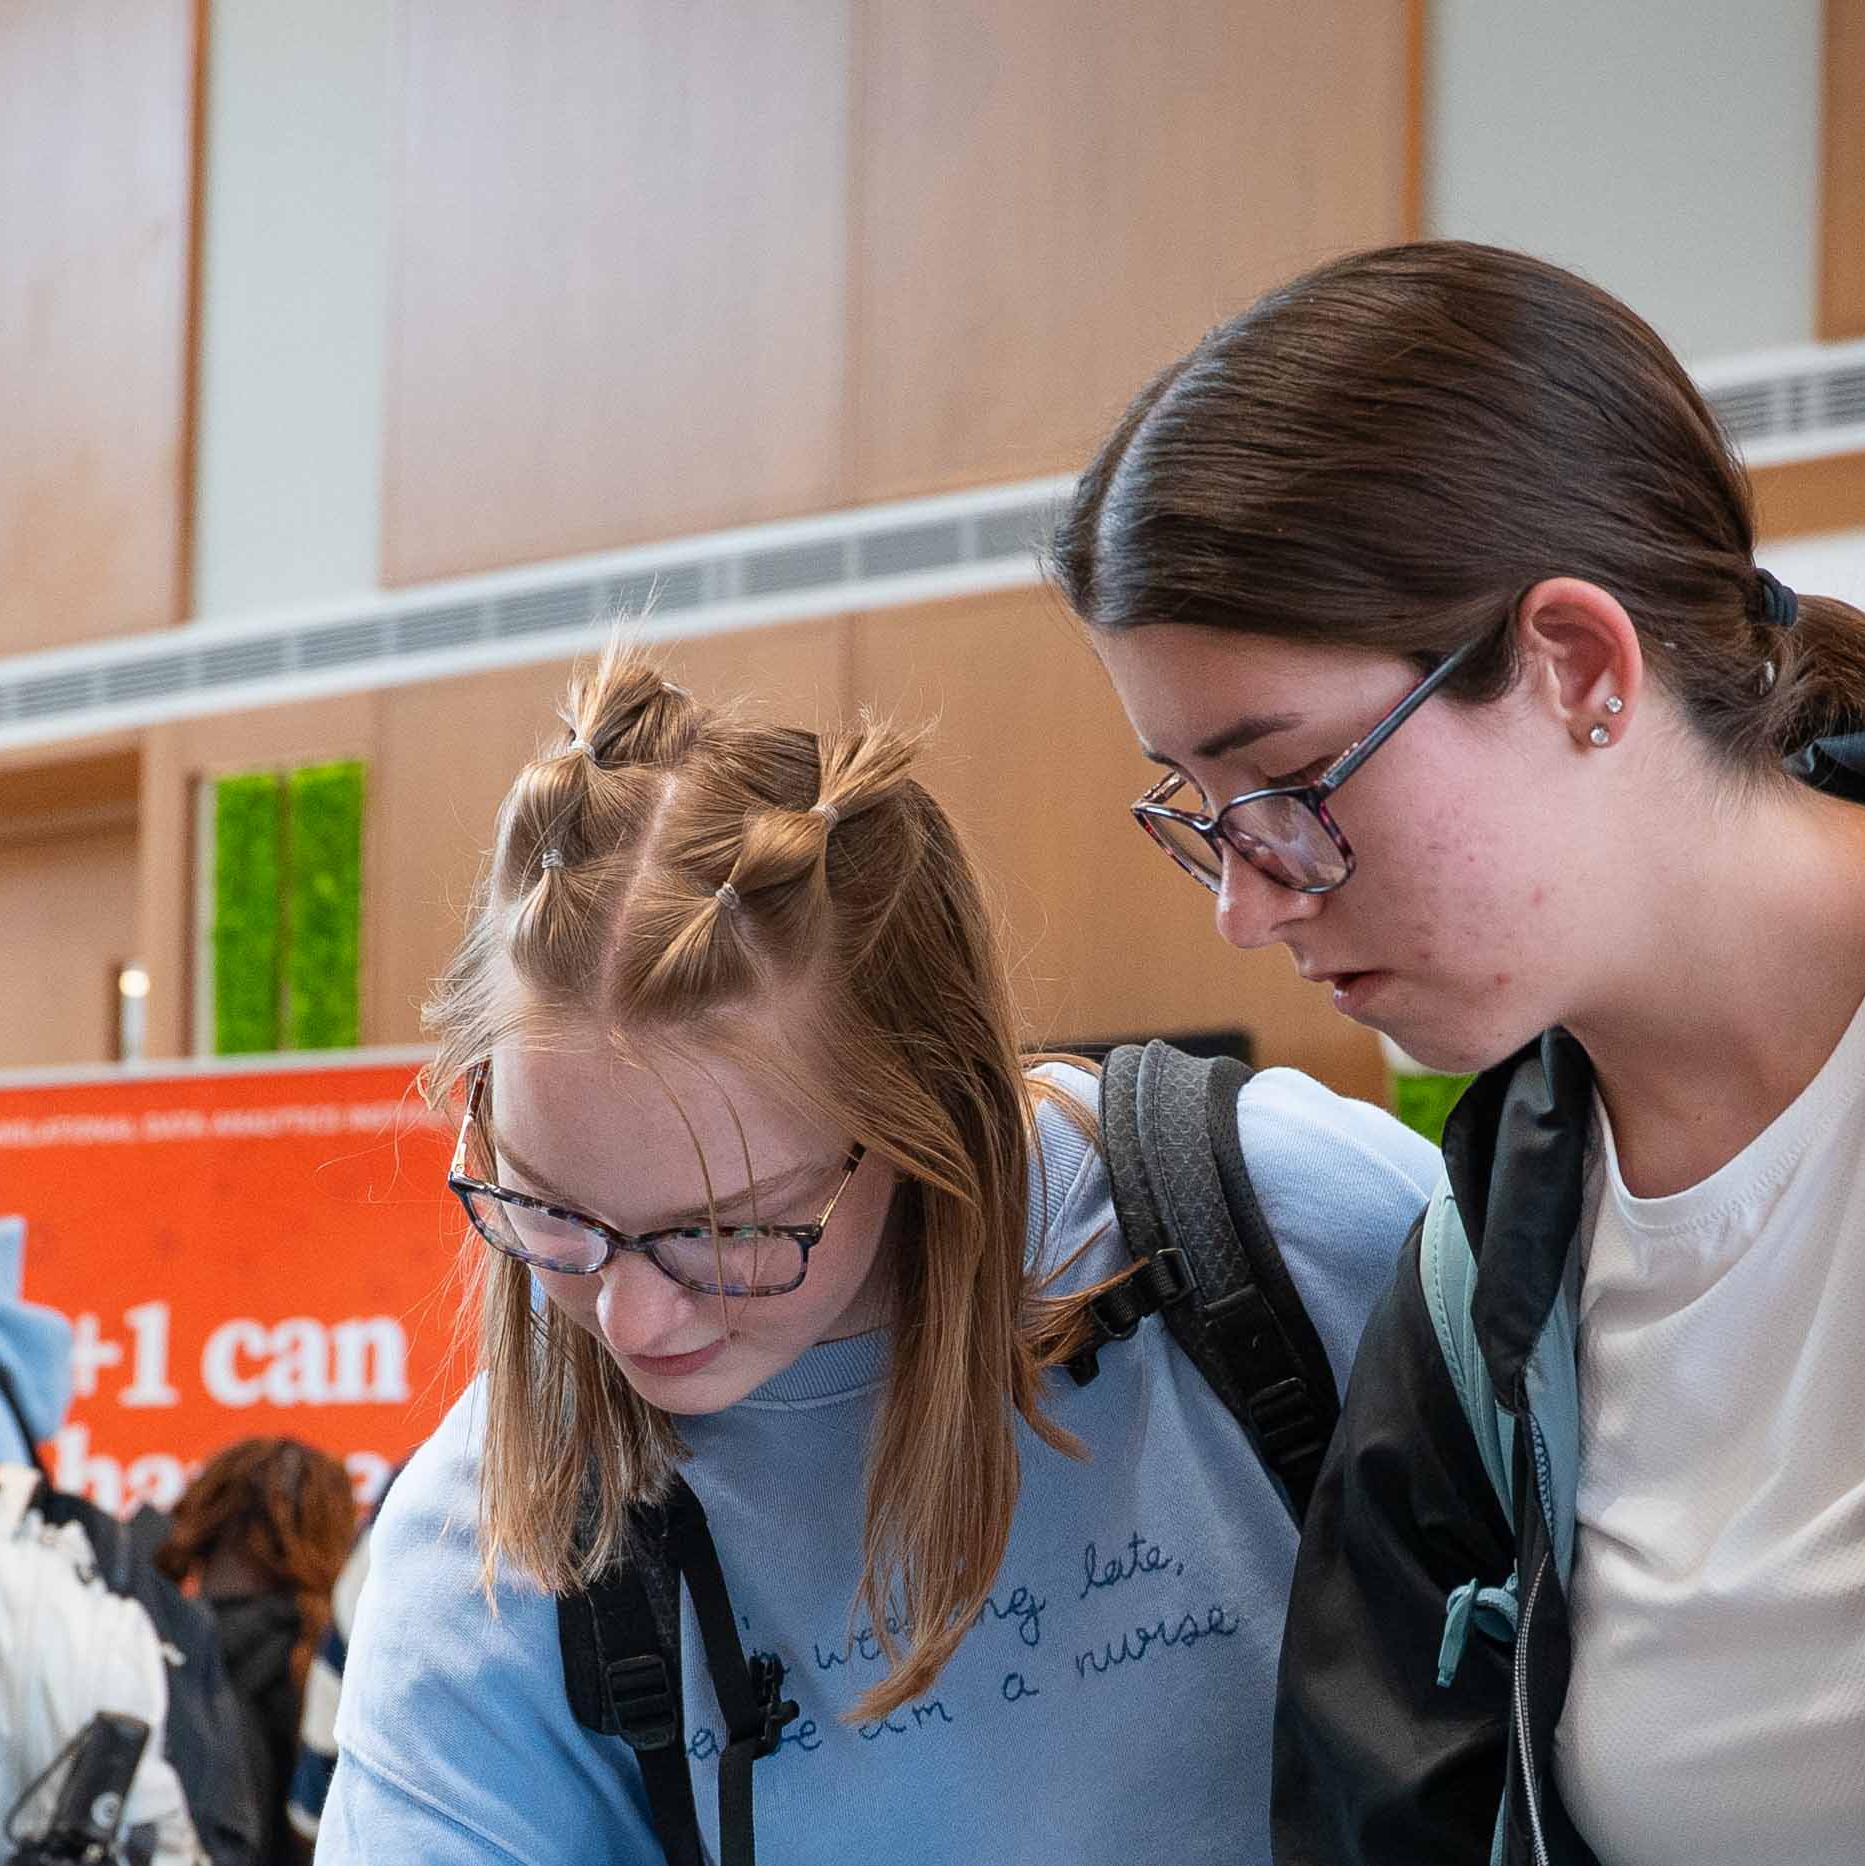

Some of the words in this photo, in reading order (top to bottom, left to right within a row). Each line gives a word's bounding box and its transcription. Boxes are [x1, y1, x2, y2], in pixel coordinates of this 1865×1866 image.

[200, 1312, 411, 1407] can
[1080, 1530, 1185, 1601] late,
[1002, 1672, 1041, 1702] a
[1074, 1604, 1241, 1679] nurse
